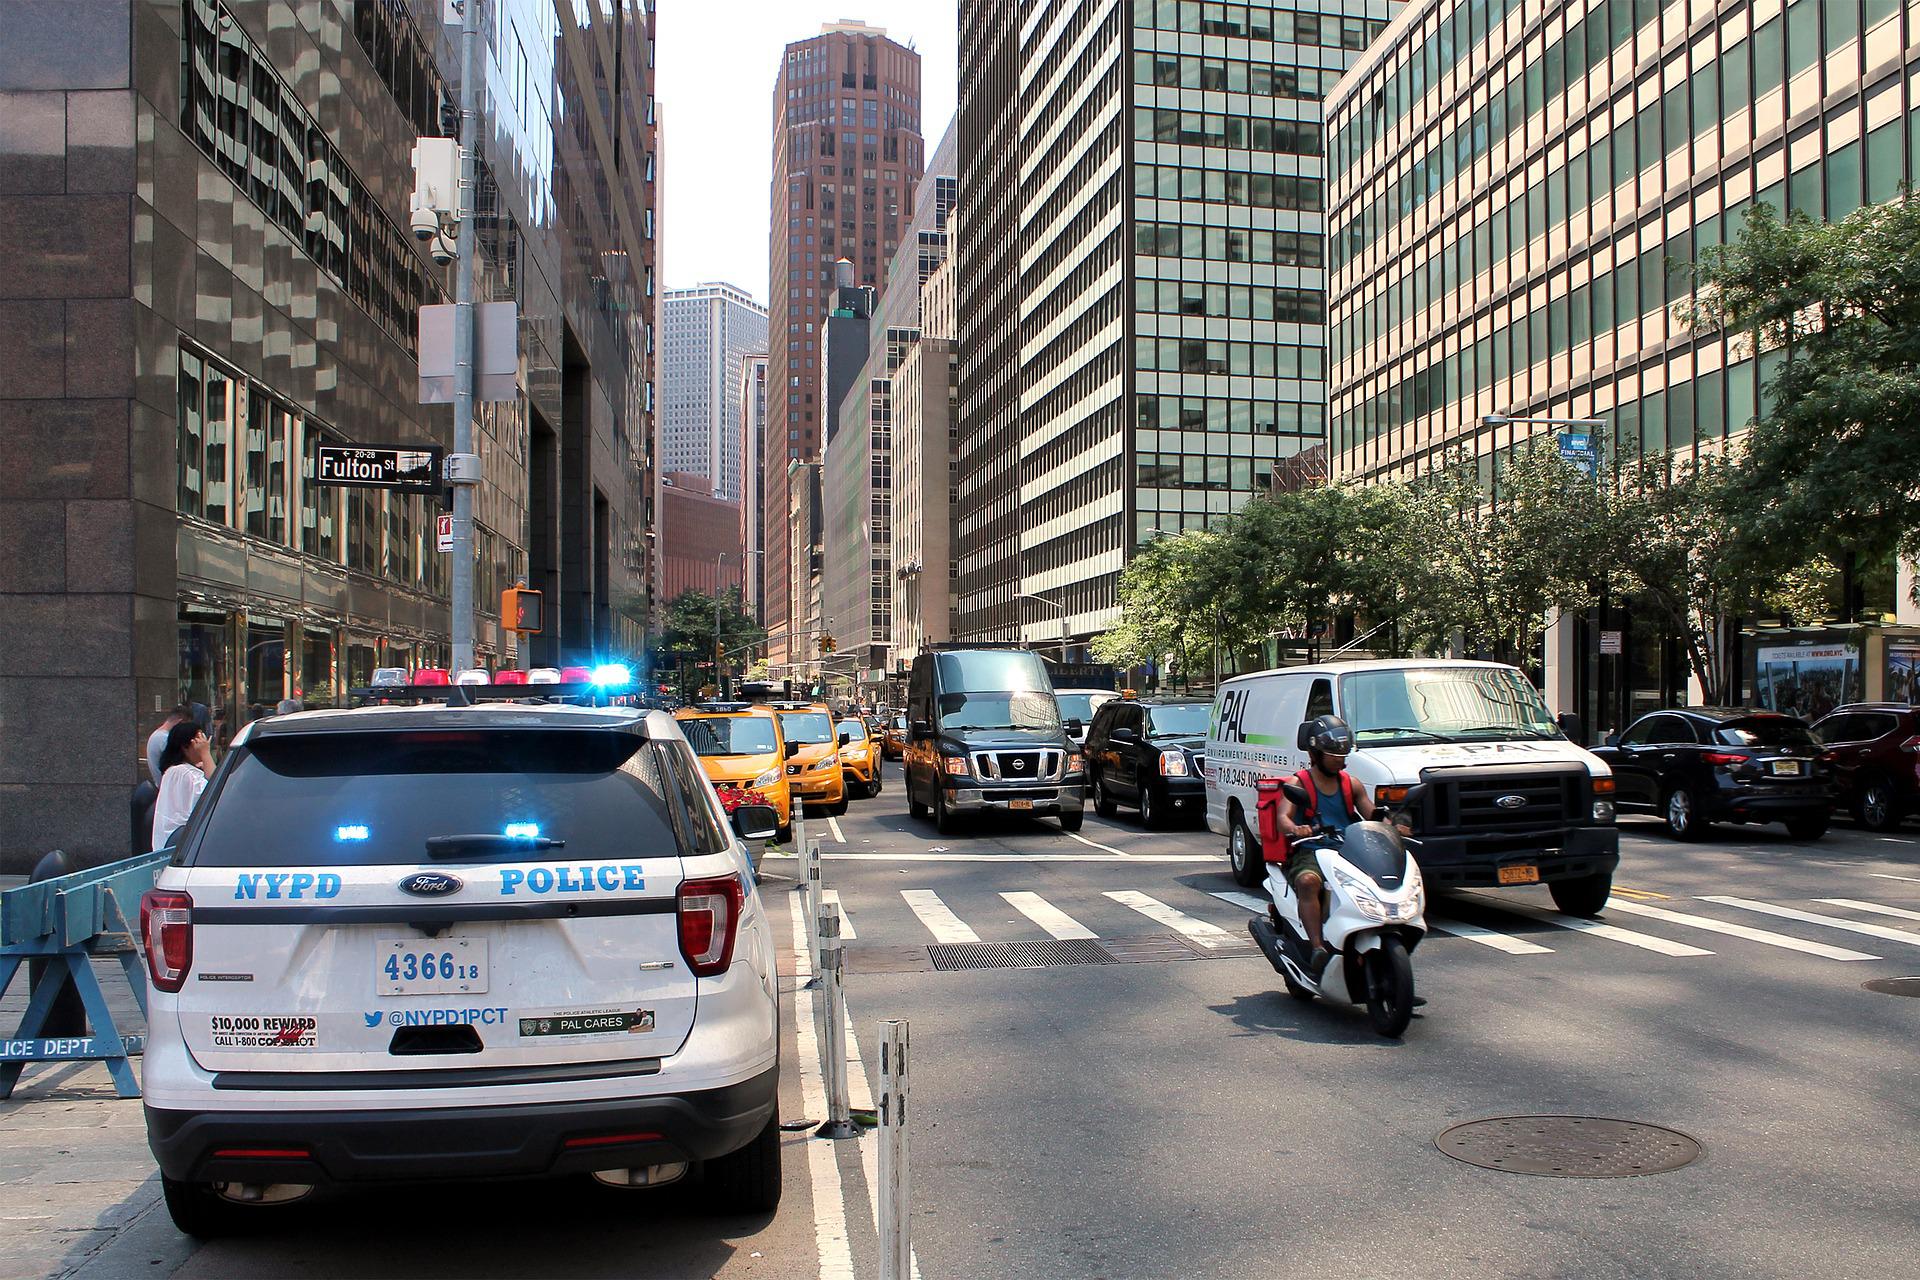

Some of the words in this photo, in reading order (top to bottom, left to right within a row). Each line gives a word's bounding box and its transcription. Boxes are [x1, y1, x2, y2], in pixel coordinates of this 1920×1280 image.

[355, 450, 376, 459] 20-28
[322, 456, 383, 479] Fulton
[384, 460, 395, 471] St
[1217, 689, 1250, 743] PAL
[1207, 748, 1251, 760] ENVIRONMENTAL
[1254, 751, 1288, 766] SERVICES
[1459, 744, 1560, 754] PAL
[234, 873, 342, 900] NYPD
[411, 875, 448, 892] Ford
[499, 865, 646, 895] POLICE
[384, 952, 455, 981] 4366
[458, 965, 479, 980] 18
[212, 1016, 259, 1031] $10,000
[263, 1017, 316, 1030] REWARD
[388, 1008, 508, 1026] @NYPD1PCT
[561, 1020, 582, 1030] PAL
[584, 1017, 623, 1029] CARES
[44, 1039, 94, 1055] DEPT.
[215, 1036, 233, 1046] CALL
[235, 1037, 256, 1046] 1-800
